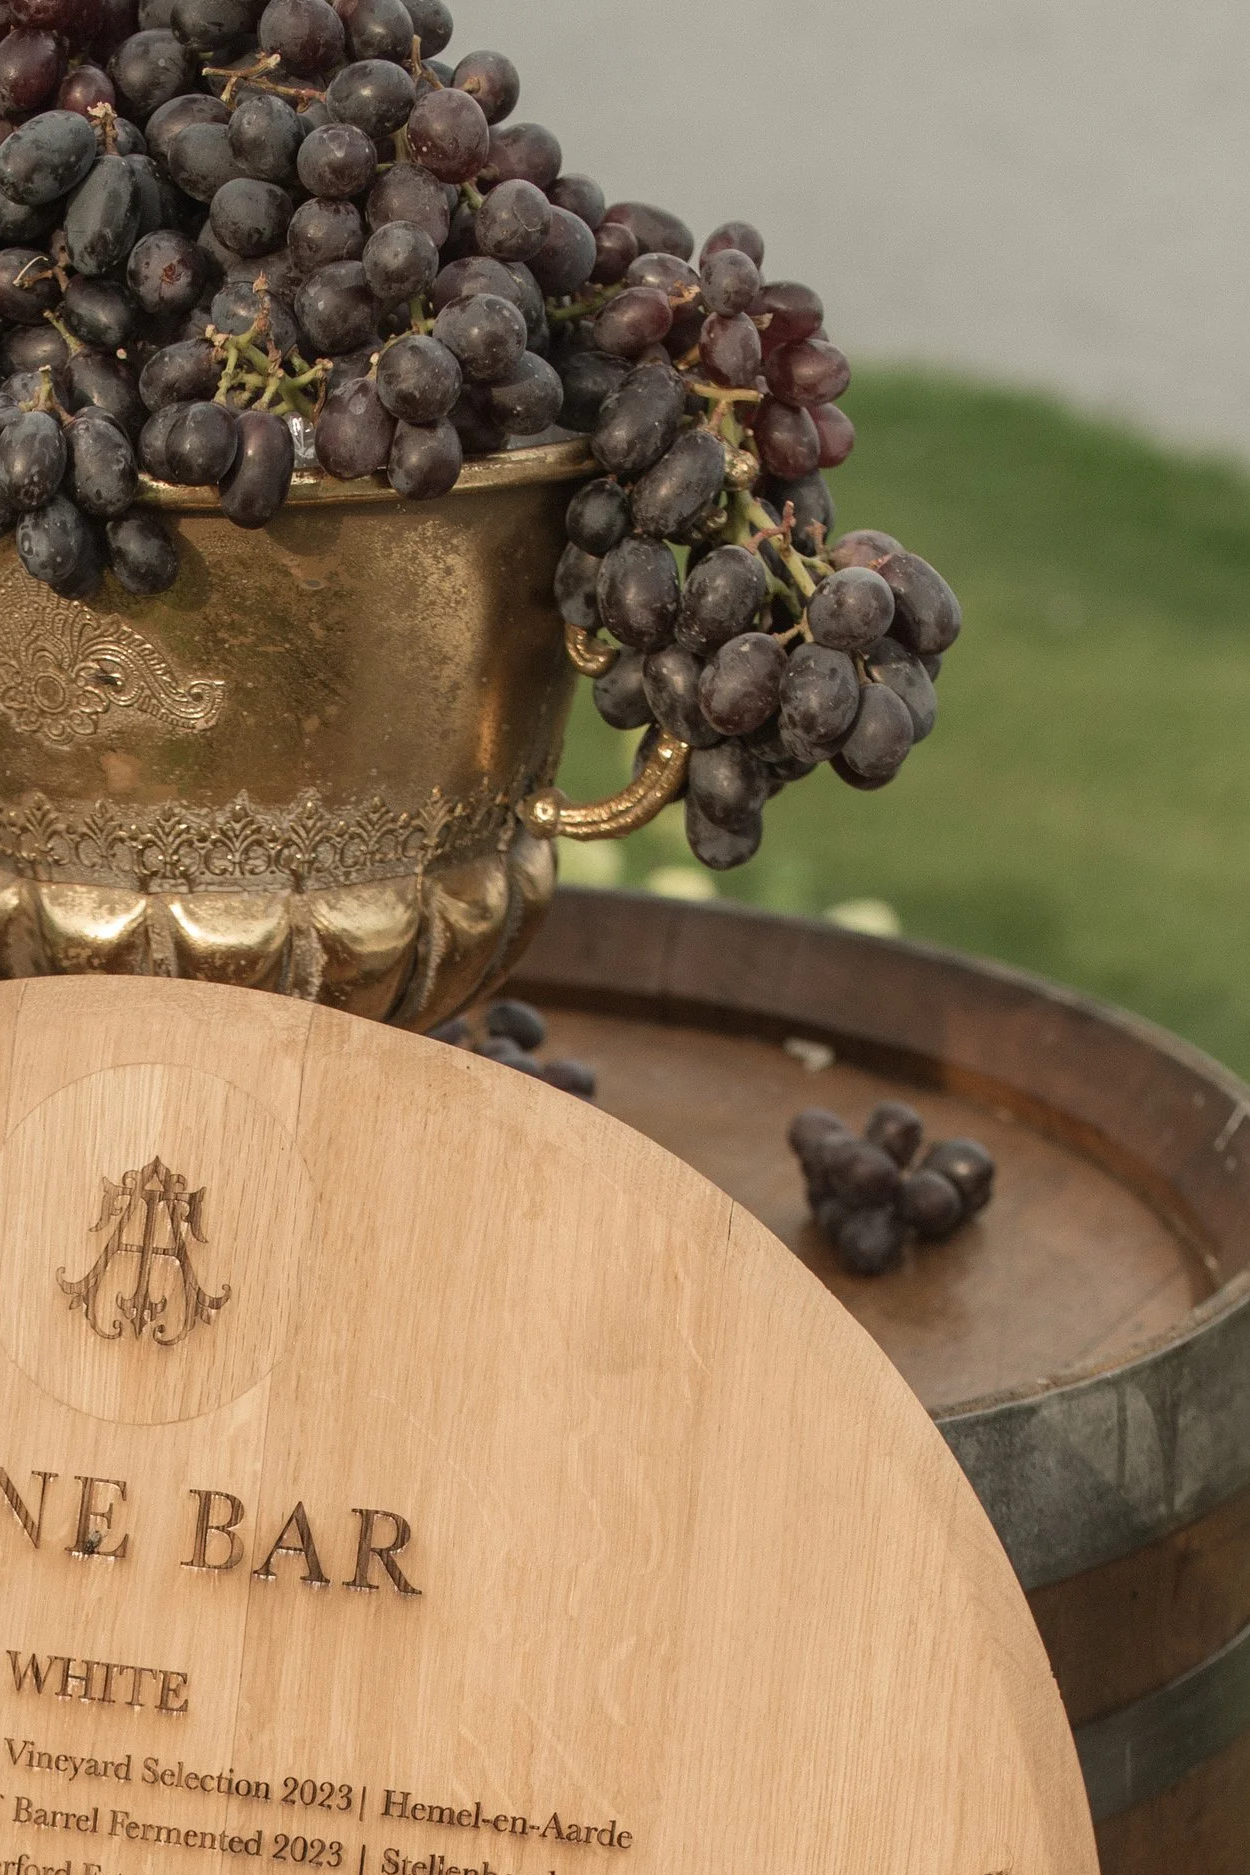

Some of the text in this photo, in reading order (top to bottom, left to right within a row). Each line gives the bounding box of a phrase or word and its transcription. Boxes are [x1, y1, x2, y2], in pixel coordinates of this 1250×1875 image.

[180, 1489, 422, 1594] BAR
[6, 1650, 188, 1713] WHITE
[4, 1738, 132, 1783] Vineyard
[142, 1758, 270, 1800] Selection
[381, 1789, 633, 1850] Hemel-en-Aarde
[13, 1797, 98, 1833] Barrel
[109, 1810, 262, 1857] Fermented
[273, 1833, 343, 1868] 2023
